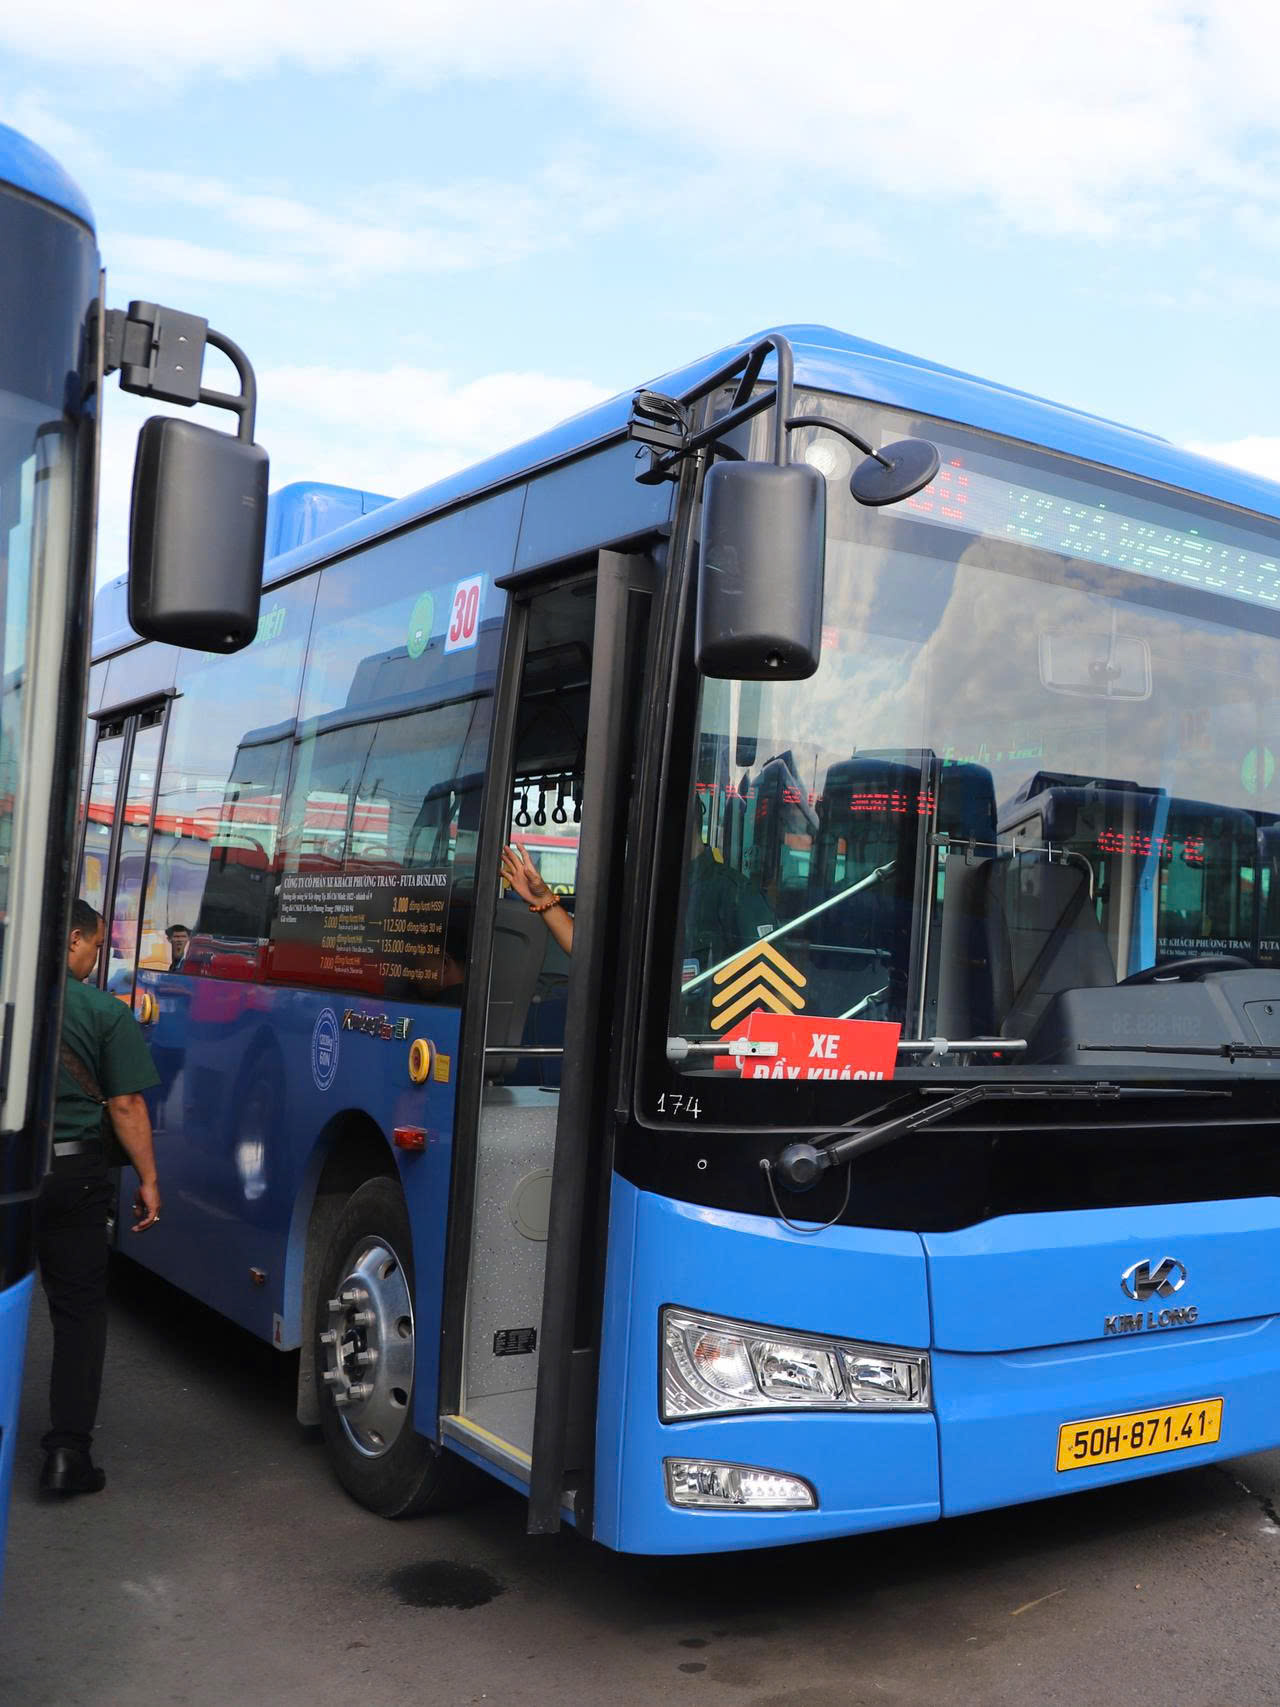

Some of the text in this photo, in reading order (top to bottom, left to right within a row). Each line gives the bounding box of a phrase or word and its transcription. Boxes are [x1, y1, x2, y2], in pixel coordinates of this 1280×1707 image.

[450, 585, 480, 642] 30
[400, 874, 415, 887] FUTA
[416, 874, 447, 887] BUSLINES
[1259, 940, 1280, 951] FUTA
[809, 1034, 840, 1059] XE
[656, 1092, 702, 1119] 174
[1103, 1305, 1199, 1336] KIM LONG
[1073, 1409, 1207, 1460] 50H-871.41
